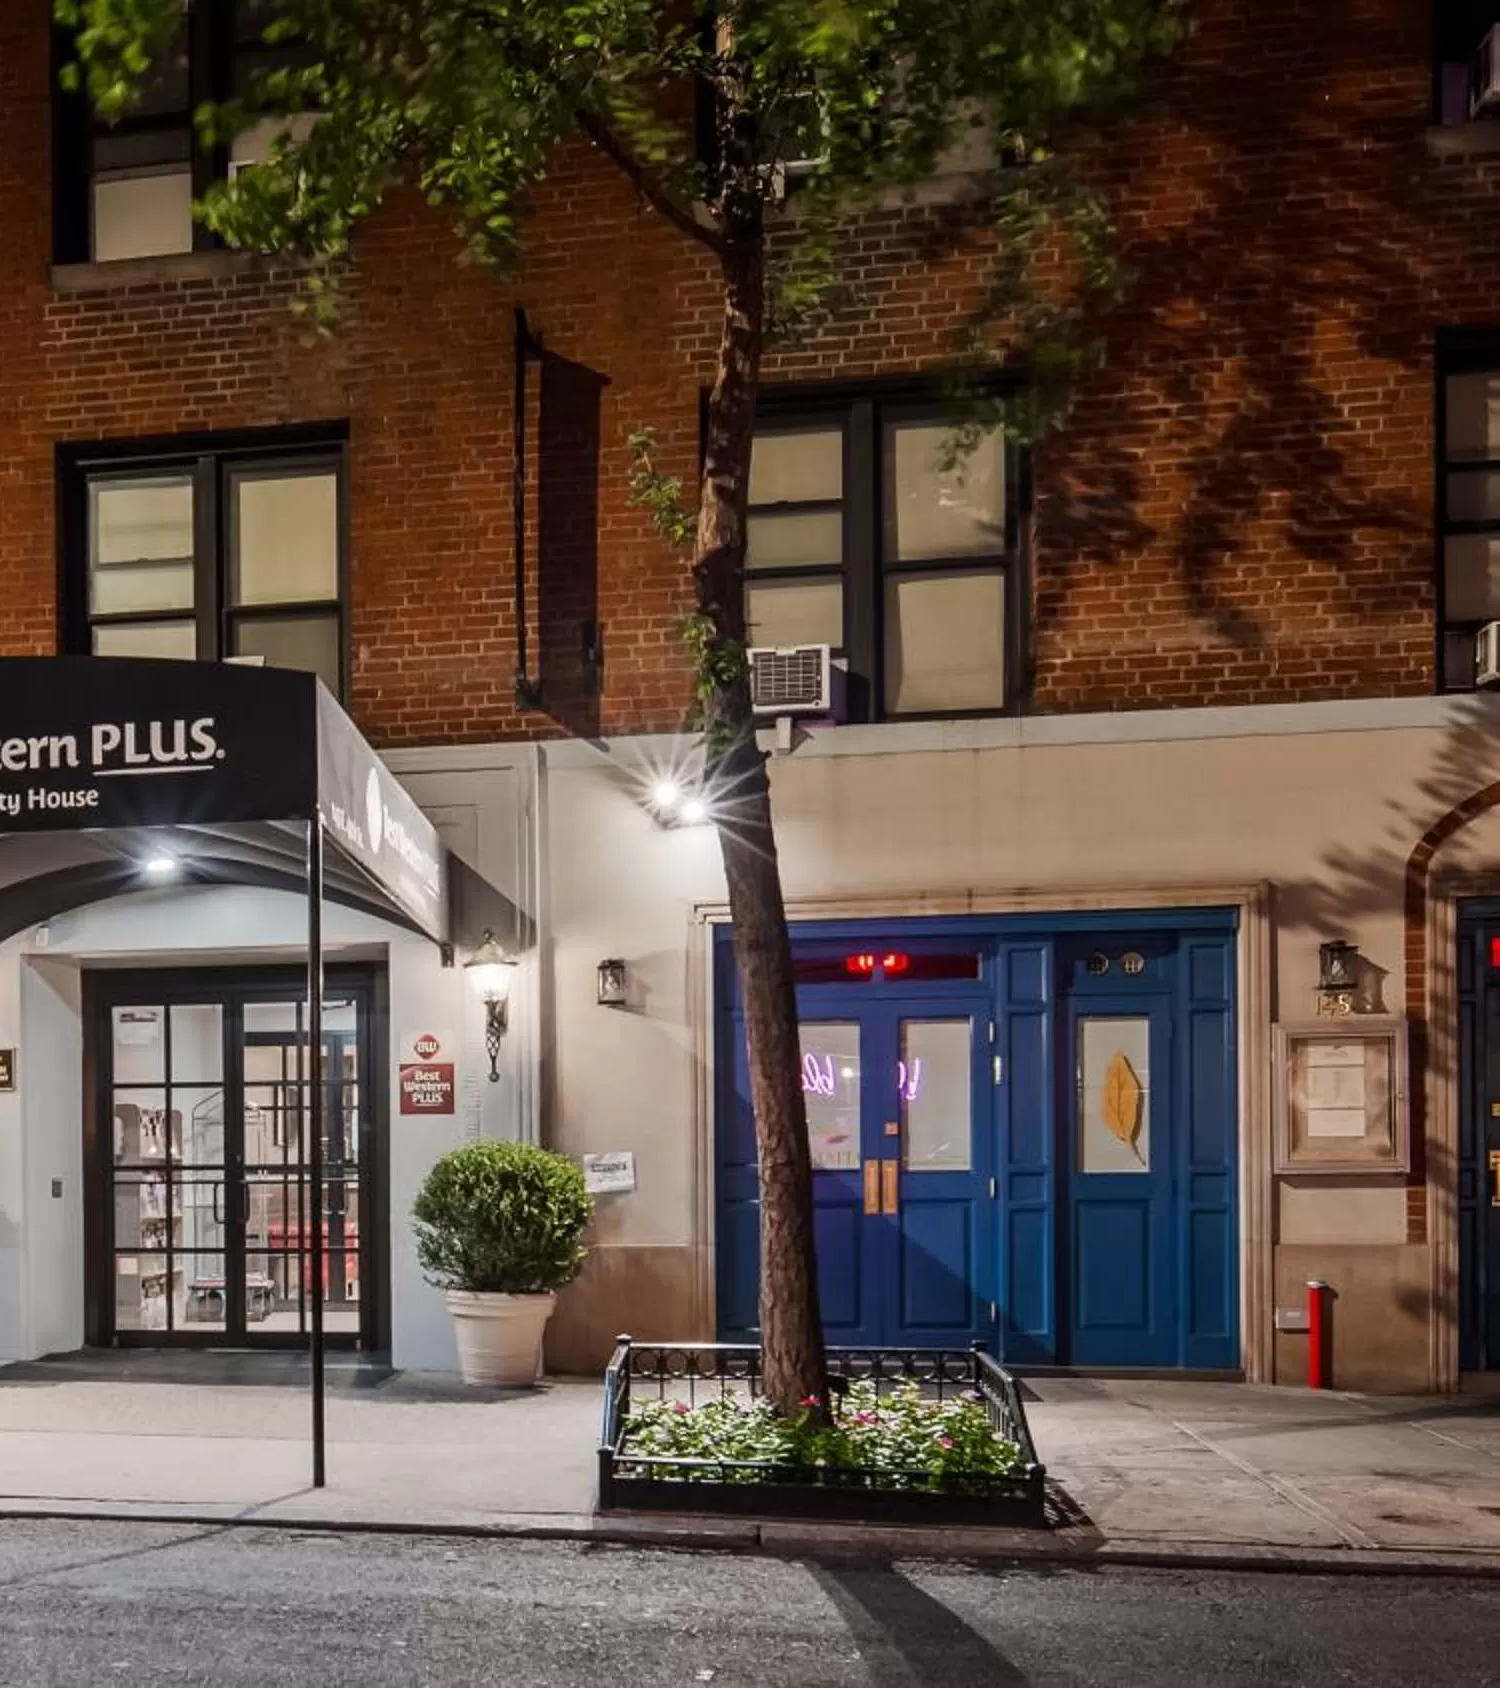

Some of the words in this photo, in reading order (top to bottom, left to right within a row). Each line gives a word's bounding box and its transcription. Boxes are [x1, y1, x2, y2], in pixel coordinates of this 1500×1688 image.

[27, 787, 99, 809] House
[414, 1070, 441, 1081] Best
[403, 1081, 451, 1093] Western
